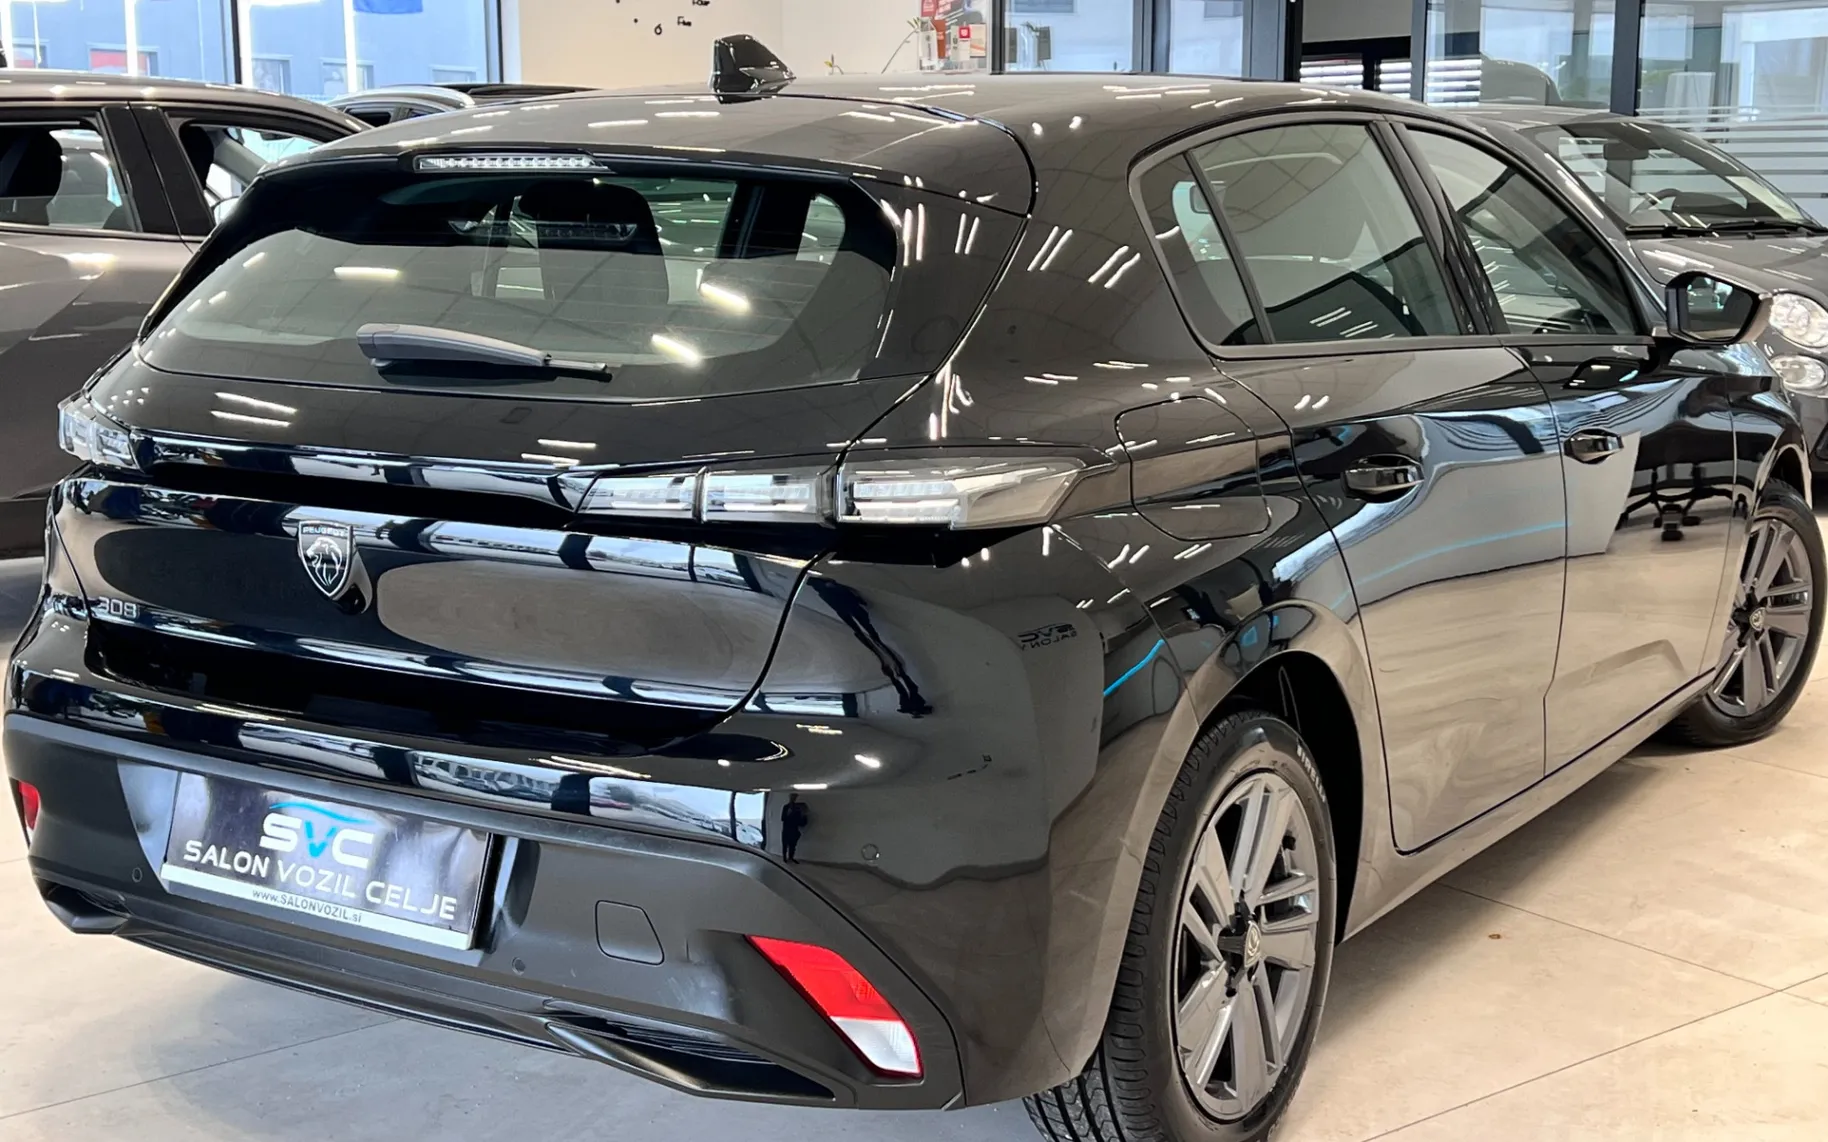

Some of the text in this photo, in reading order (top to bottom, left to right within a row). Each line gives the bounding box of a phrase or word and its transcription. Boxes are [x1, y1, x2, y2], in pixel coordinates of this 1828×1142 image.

[654, 23, 662, 35] 6
[259, 812, 374, 869] SVC
[183, 840, 458, 920] SALON VOZIL CELJE
[252, 889, 363, 924] www.SALONVOZIL.si
